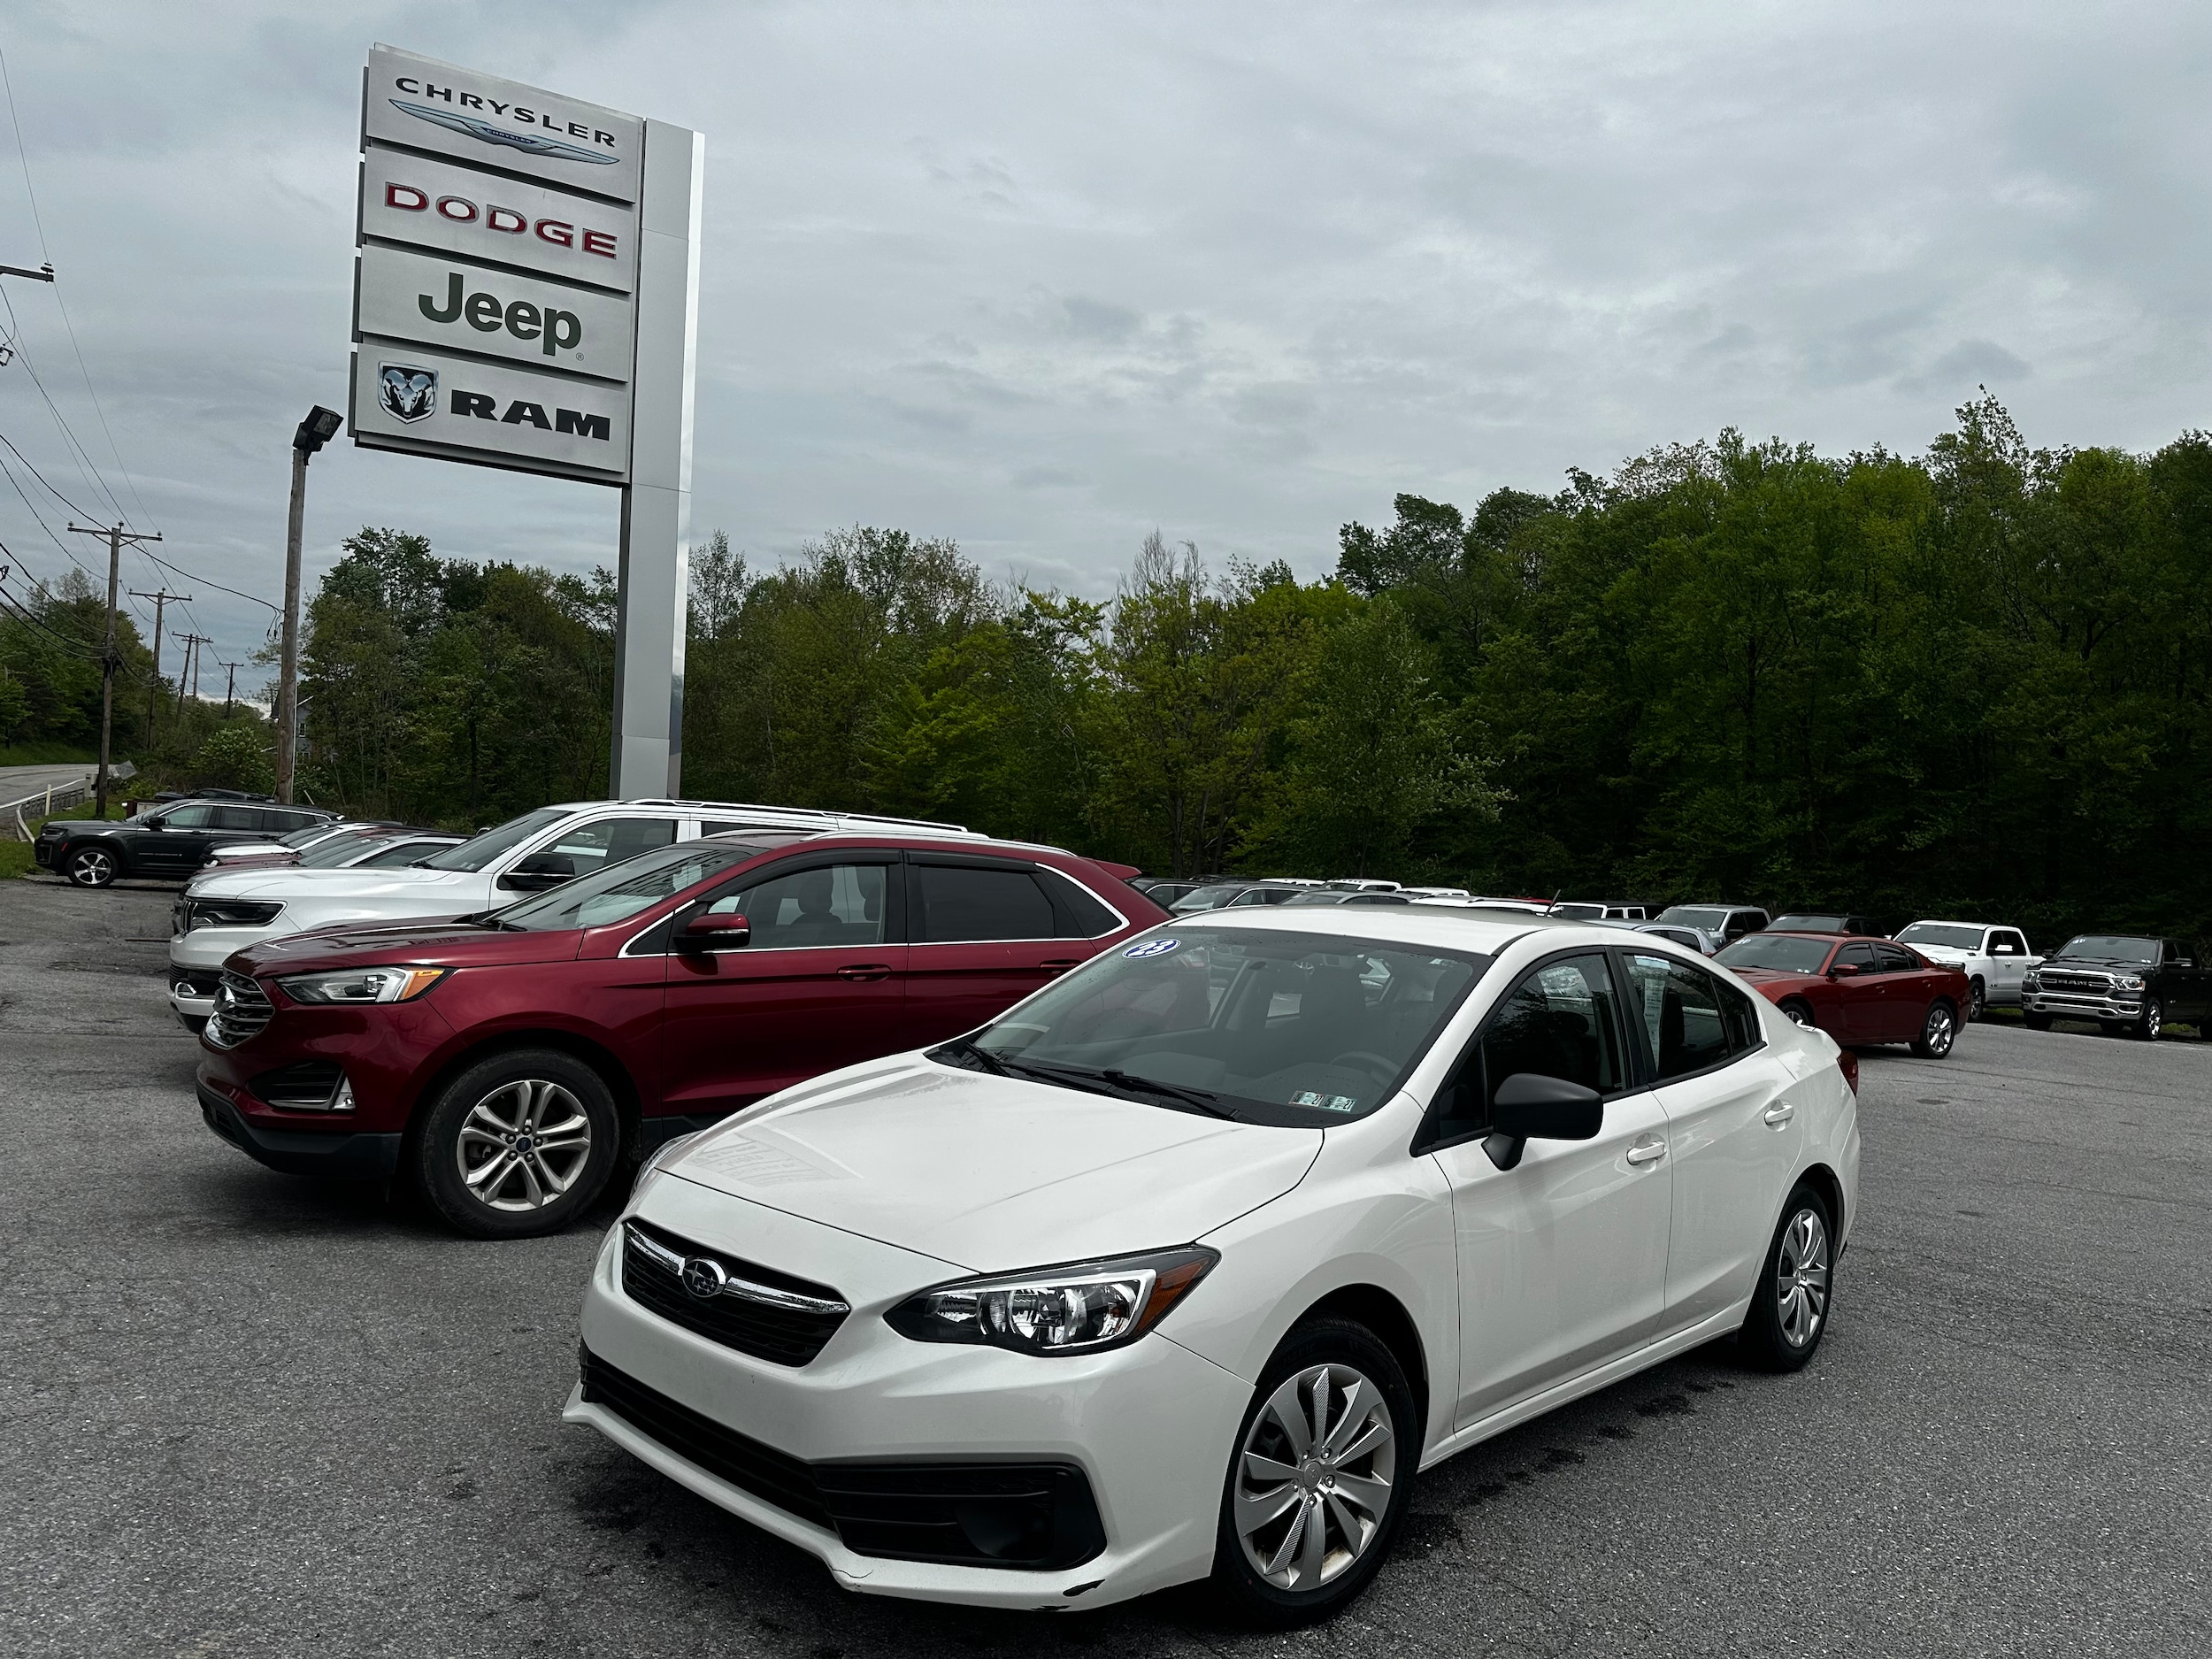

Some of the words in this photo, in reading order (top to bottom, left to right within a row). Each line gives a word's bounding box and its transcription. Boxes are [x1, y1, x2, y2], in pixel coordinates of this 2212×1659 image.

[396, 77, 616, 148] CHRYSLER
[385, 181, 618, 260] DODGE
[419, 273, 581, 356] Jeep
[450, 389, 611, 442] RAM
[1128, 940, 1175, 956] 23
[1311, 1094, 1323, 1105] 27
[1343, 1099, 1354, 1110] 27
